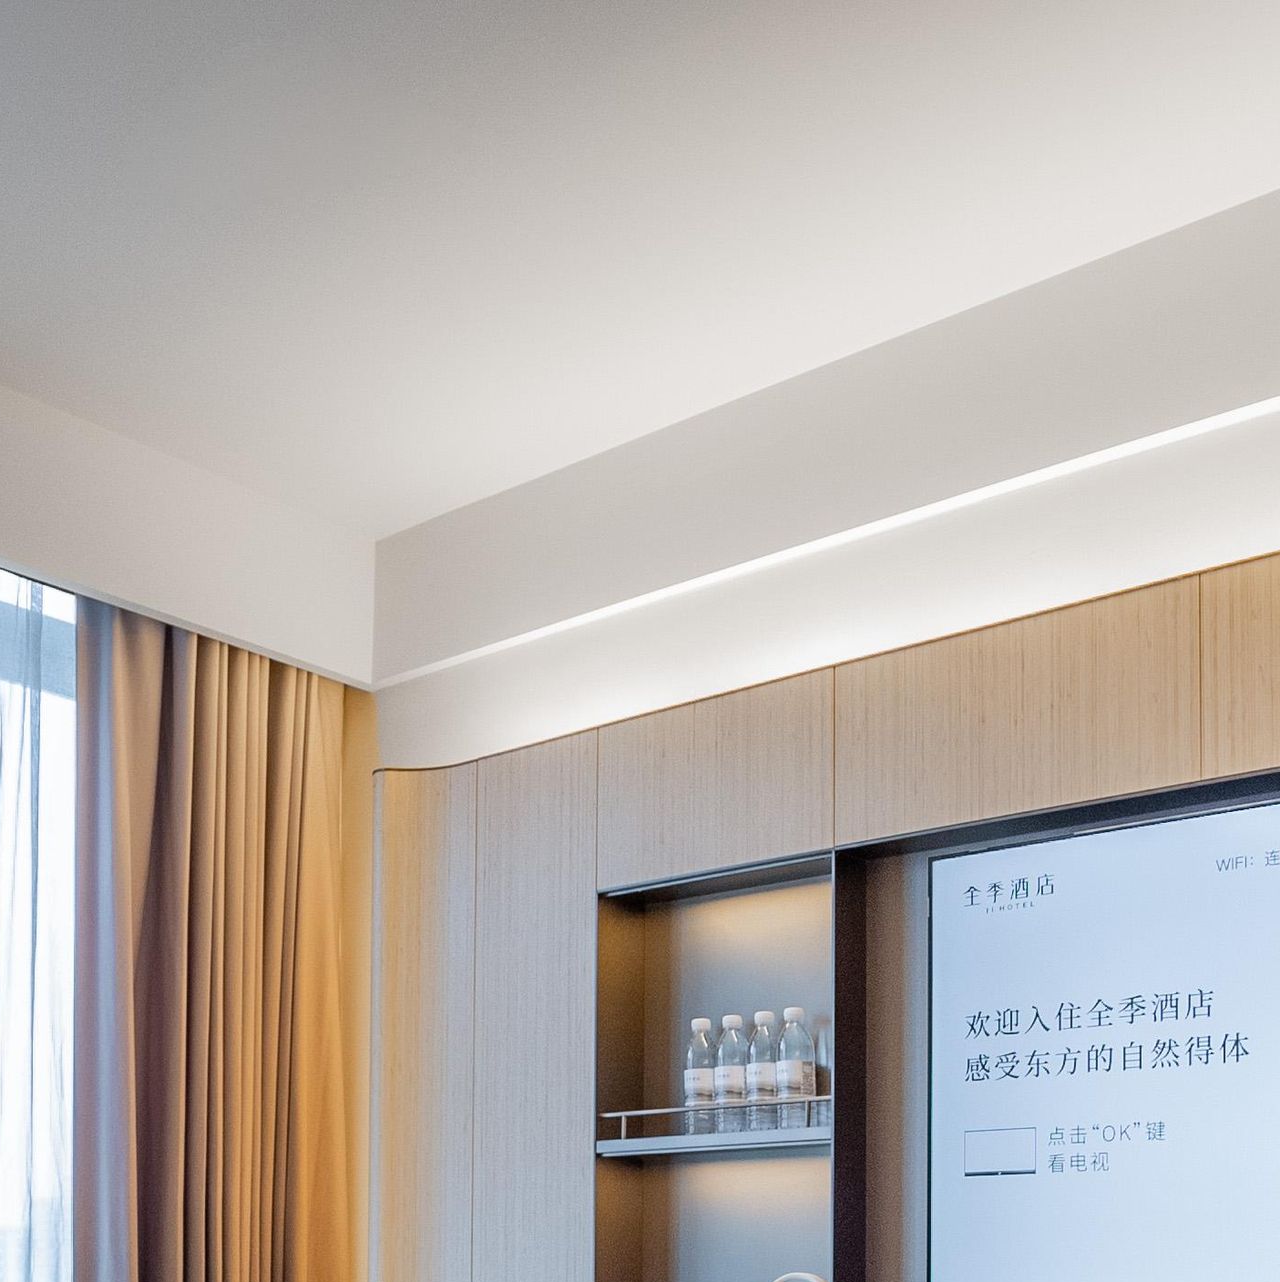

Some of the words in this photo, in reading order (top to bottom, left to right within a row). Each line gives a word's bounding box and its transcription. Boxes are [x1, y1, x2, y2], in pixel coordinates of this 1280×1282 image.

[963, 873, 1055, 907] 全季酒店
[964, 987, 1216, 1039] 欢迎入住全季酒店
[964, 1031, 1251, 1083] 感受东方的自然得体
[1047, 1151, 1110, 1174] 看电视
